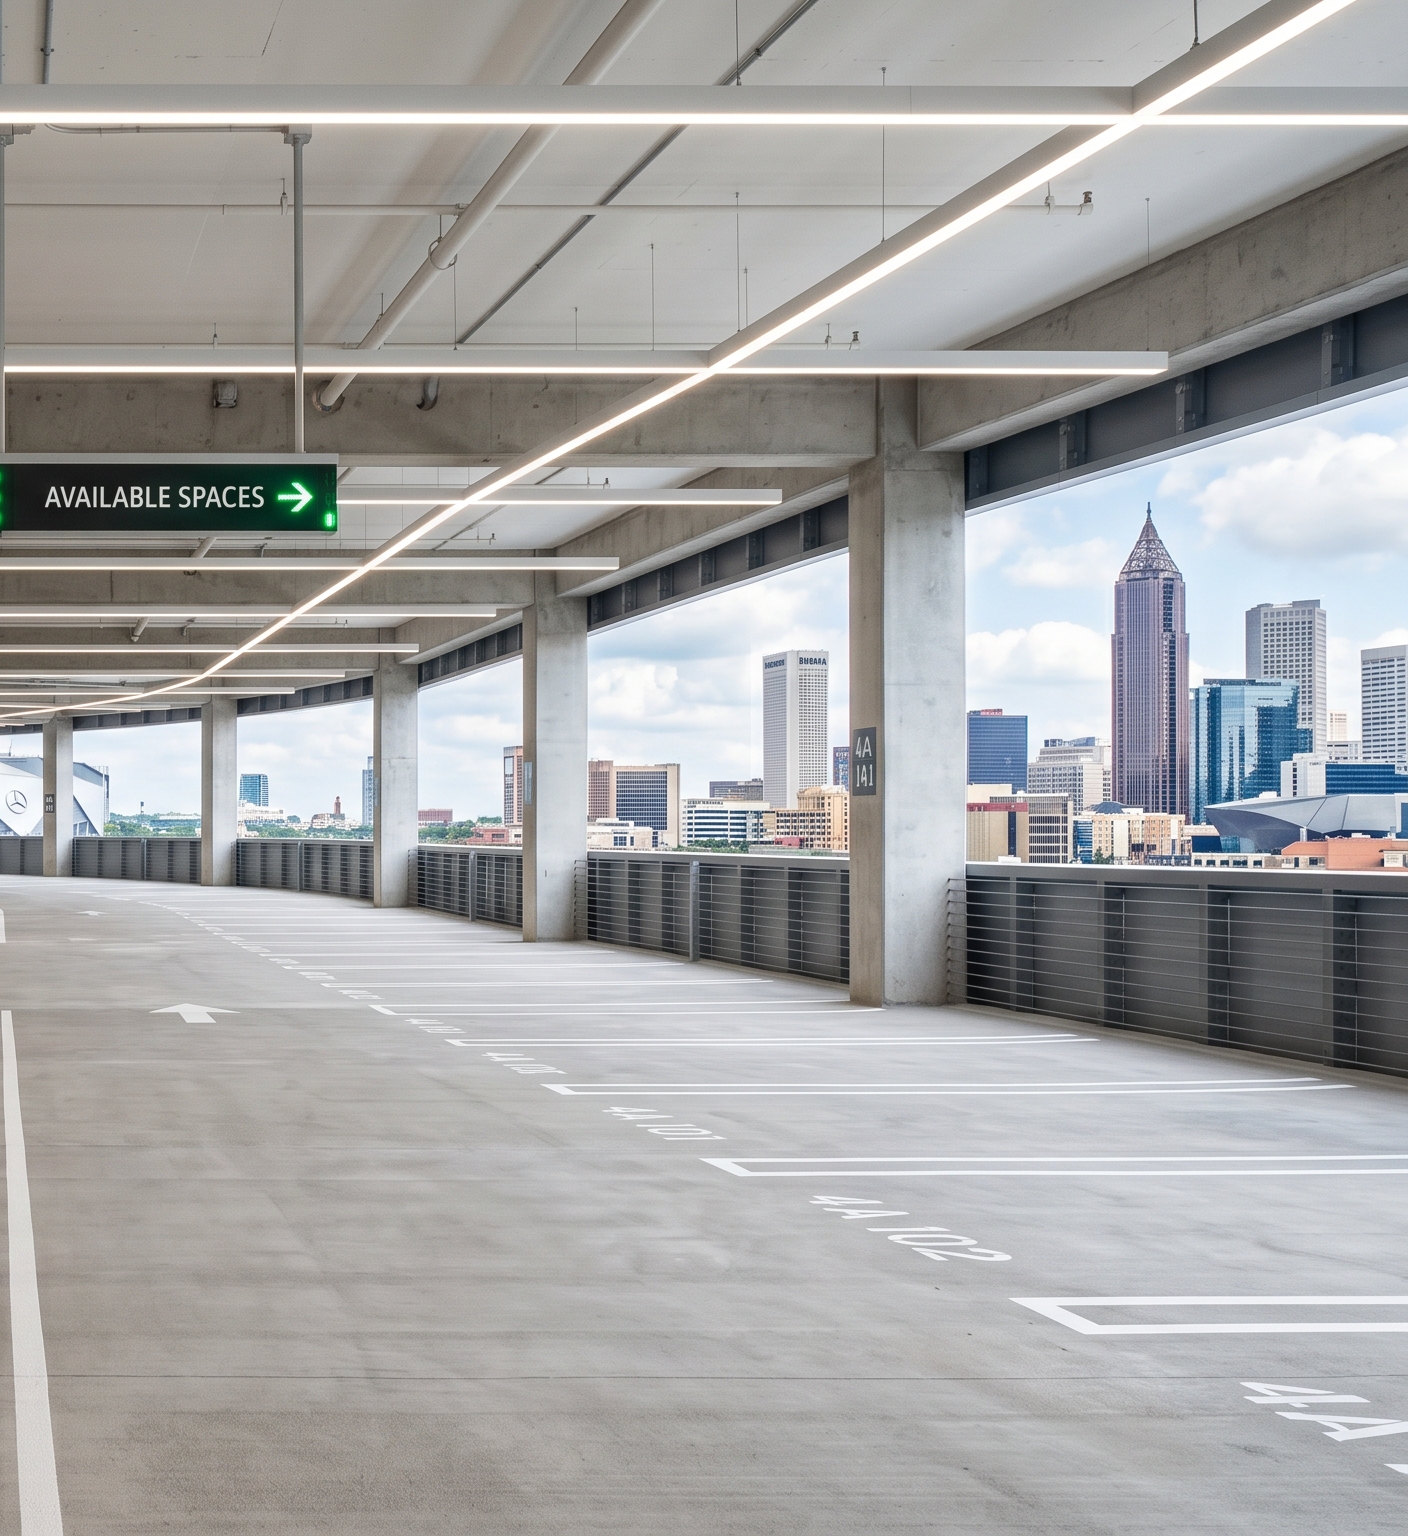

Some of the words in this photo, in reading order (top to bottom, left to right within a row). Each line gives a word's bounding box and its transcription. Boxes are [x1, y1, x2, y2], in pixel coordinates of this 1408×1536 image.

[44, 485, 171, 508] AVAILABLE
[178, 485, 265, 509] SPACES
[855, 736, 873, 758] 4A
[602, 1106, 674, 1121] 4A
[636, 1123, 728, 1141] 101
[808, 1195, 910, 1220] 4A
[865, 1226, 1013, 1262] 102
[1239, 1381, 1408, 1442] 4A
